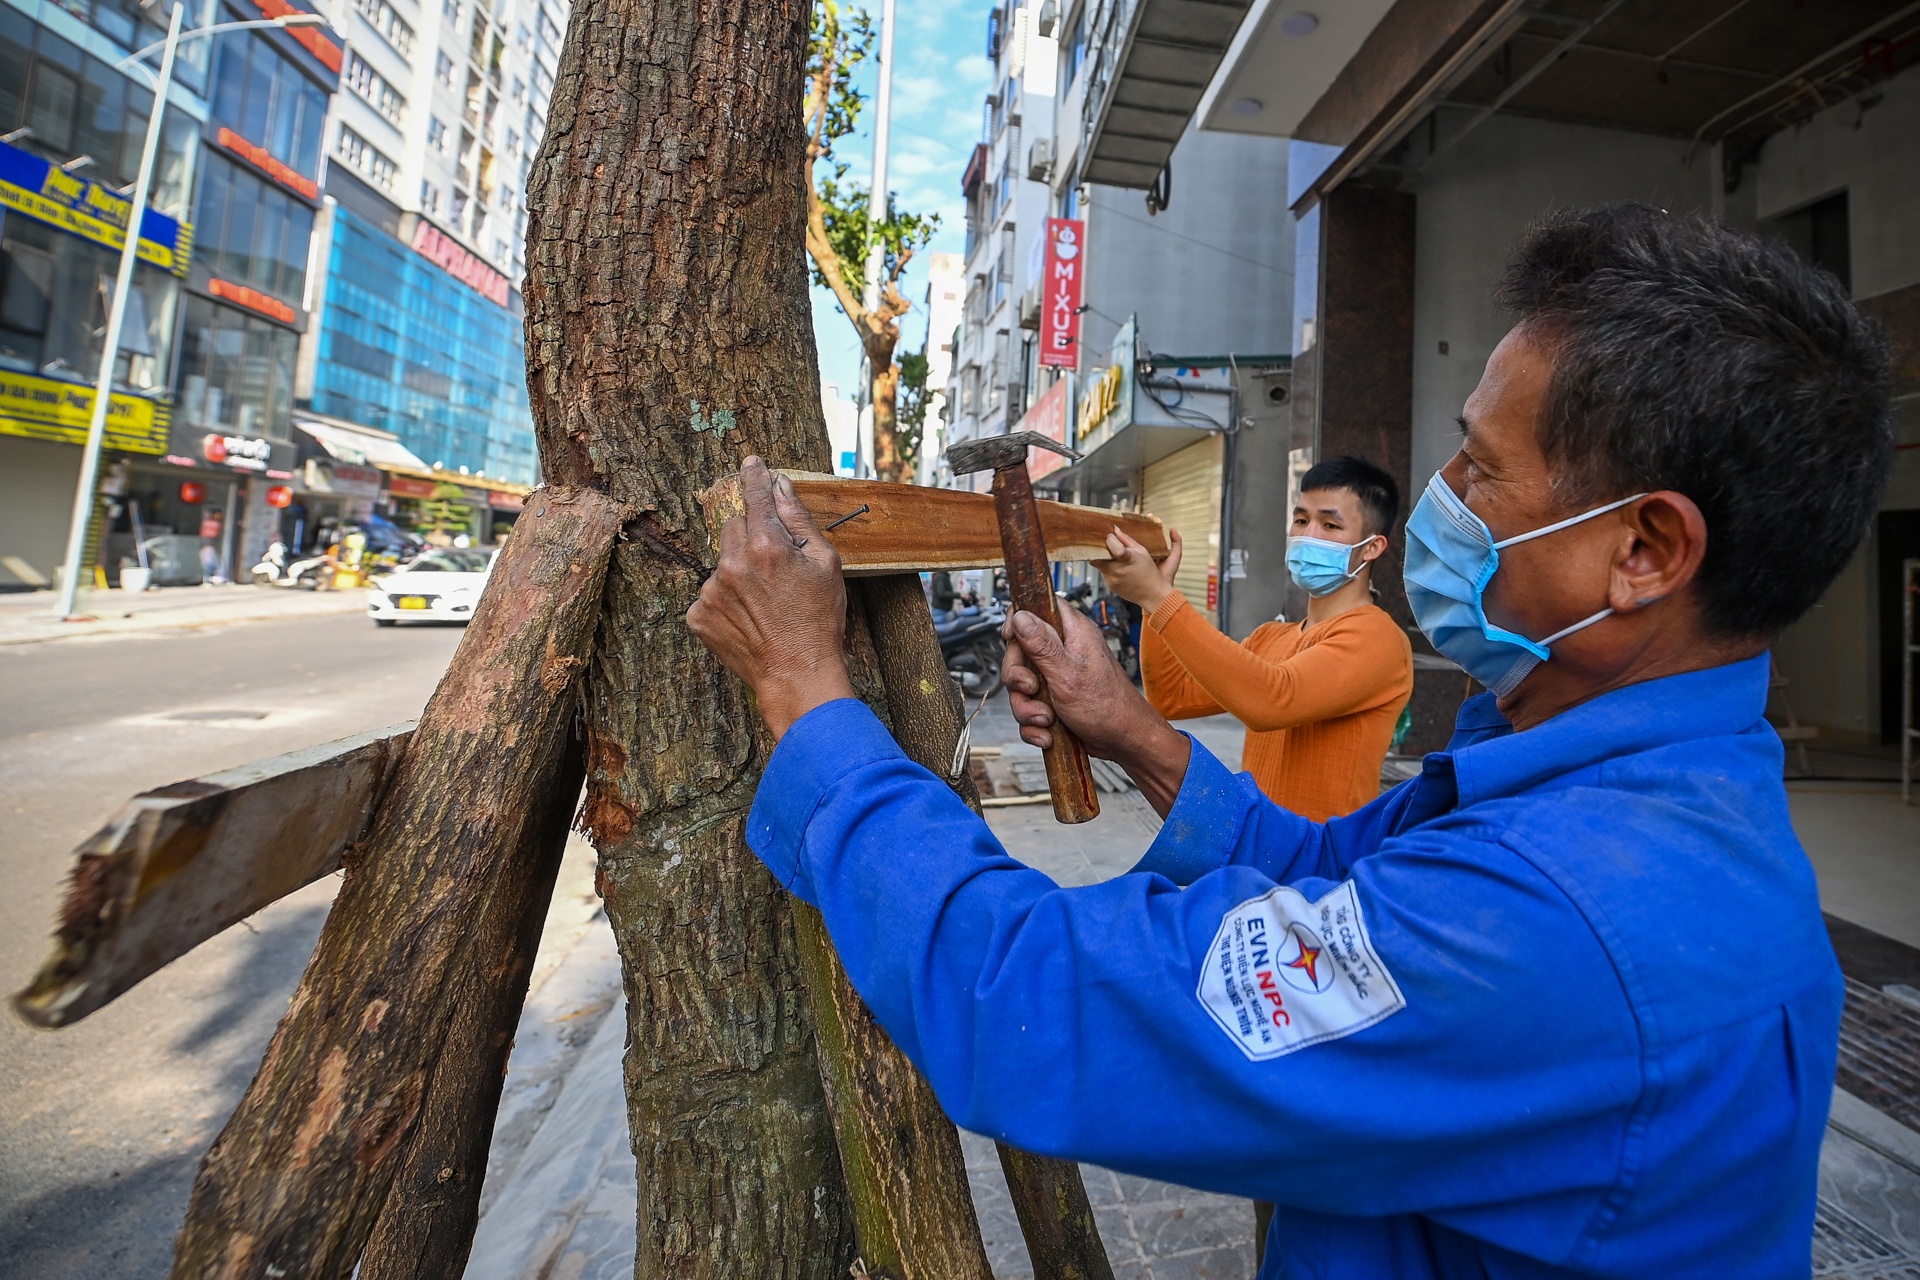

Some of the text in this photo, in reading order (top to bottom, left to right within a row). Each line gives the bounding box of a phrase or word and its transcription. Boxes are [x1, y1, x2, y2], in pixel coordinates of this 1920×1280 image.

[1052, 261, 1075, 351] MIXUE
[1339, 926, 1360, 963] CÔNG
[1358, 961, 1373, 978] TY
[1261, 1028, 1273, 1045] AN
